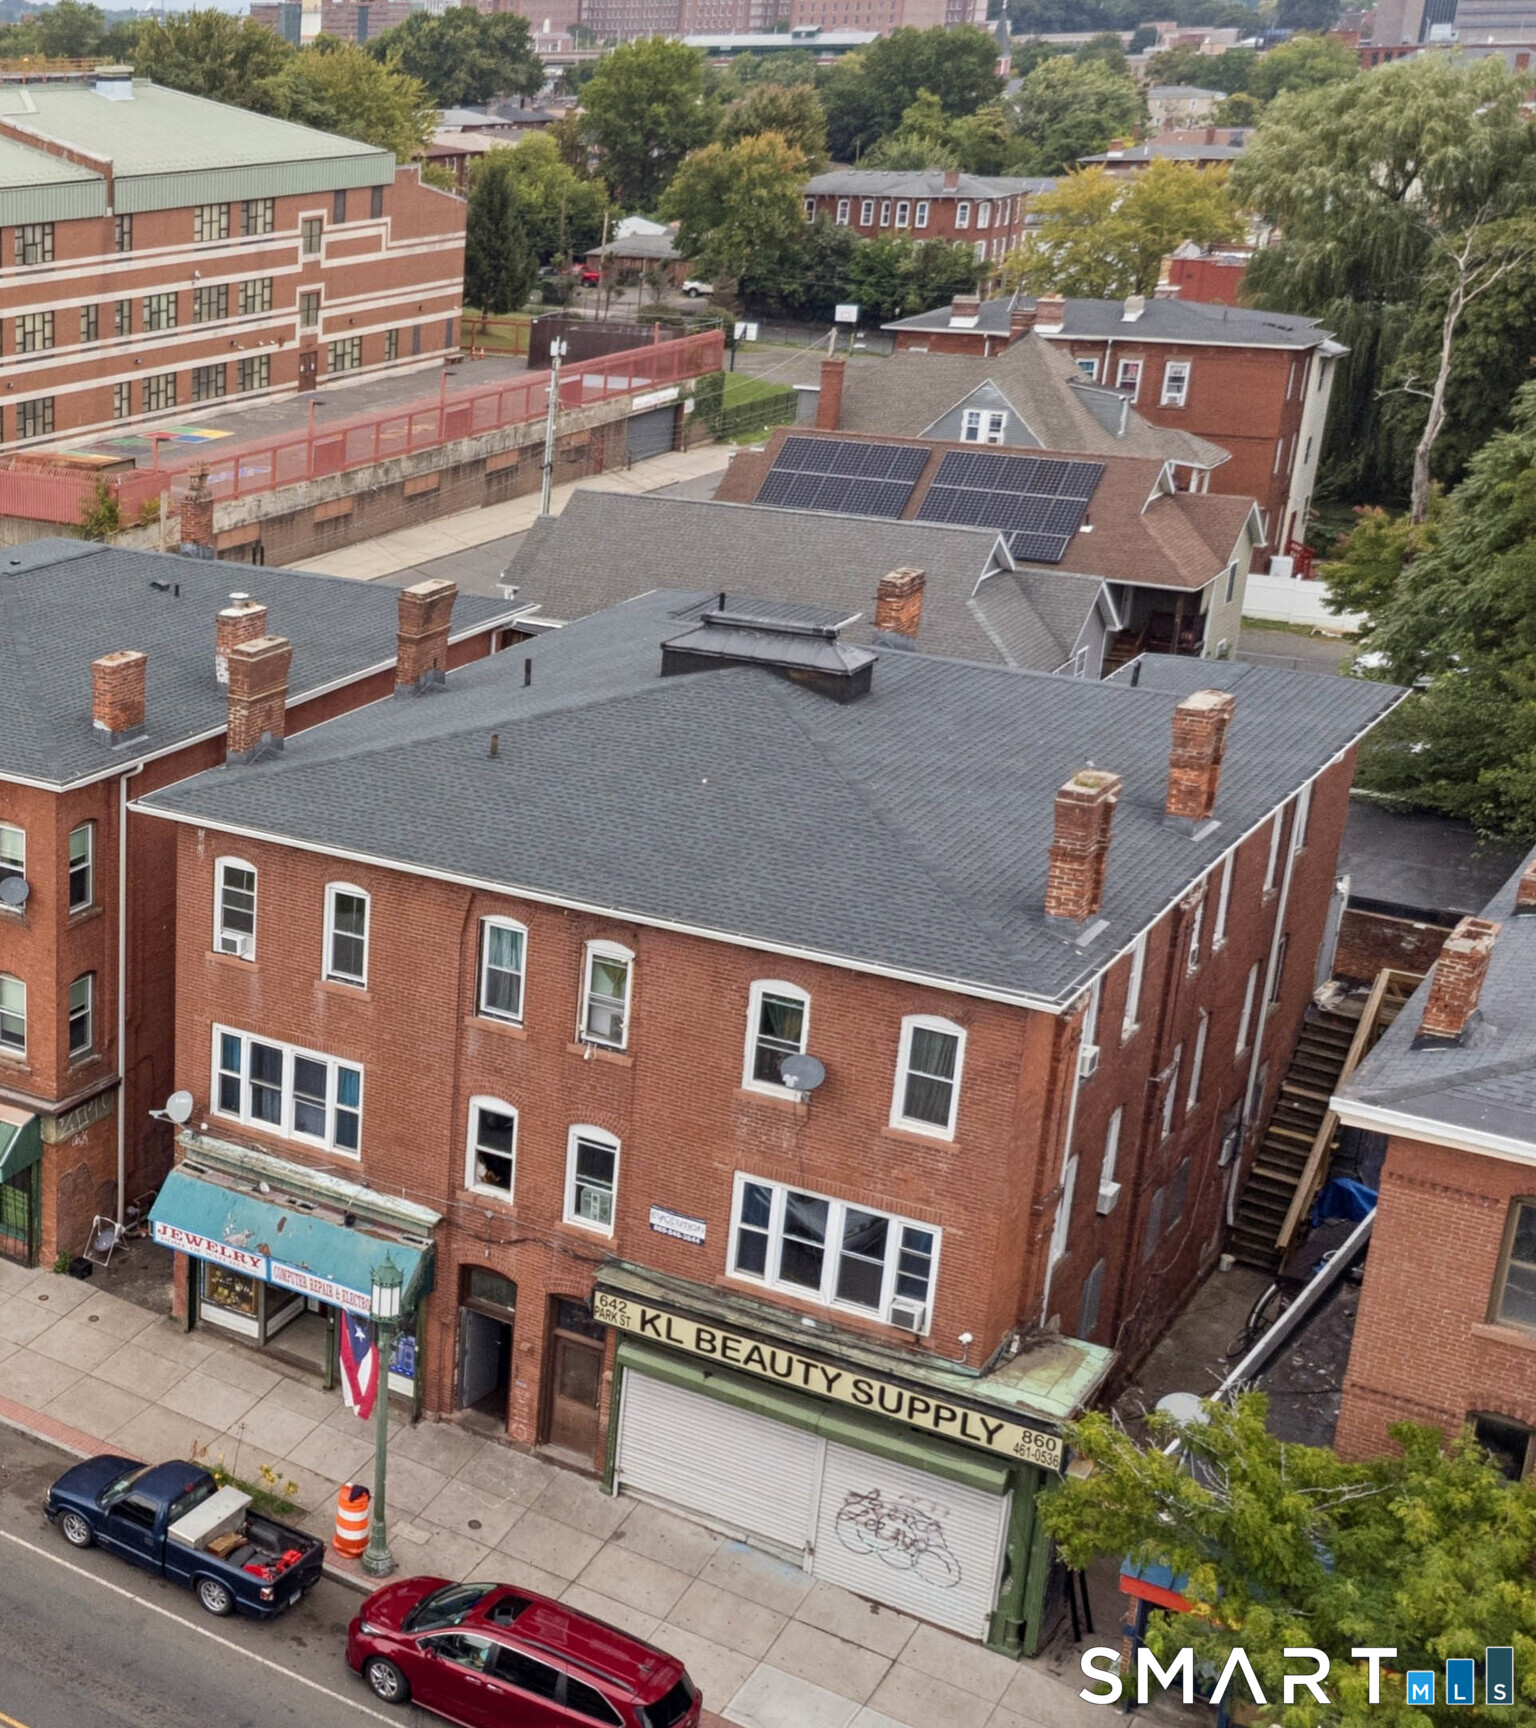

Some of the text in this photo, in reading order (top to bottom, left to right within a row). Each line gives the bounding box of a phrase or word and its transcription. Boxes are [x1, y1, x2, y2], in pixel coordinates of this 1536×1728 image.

[157, 1225, 261, 1268] JEWELRY
[274, 1265, 307, 1288] COMPUTER
[309, 1277, 333, 1297] REPAIR
[342, 1289, 371, 1311] ELECTRO
[594, 1305, 631, 1328] PARK ST
[600, 1294, 627, 1314] 642
[640, 1309, 1004, 1445] KL BEAUTY SUPPLY
[1021, 1430, 1056, 1451] 860
[1013, 1442, 1059, 1468] 461-0536
